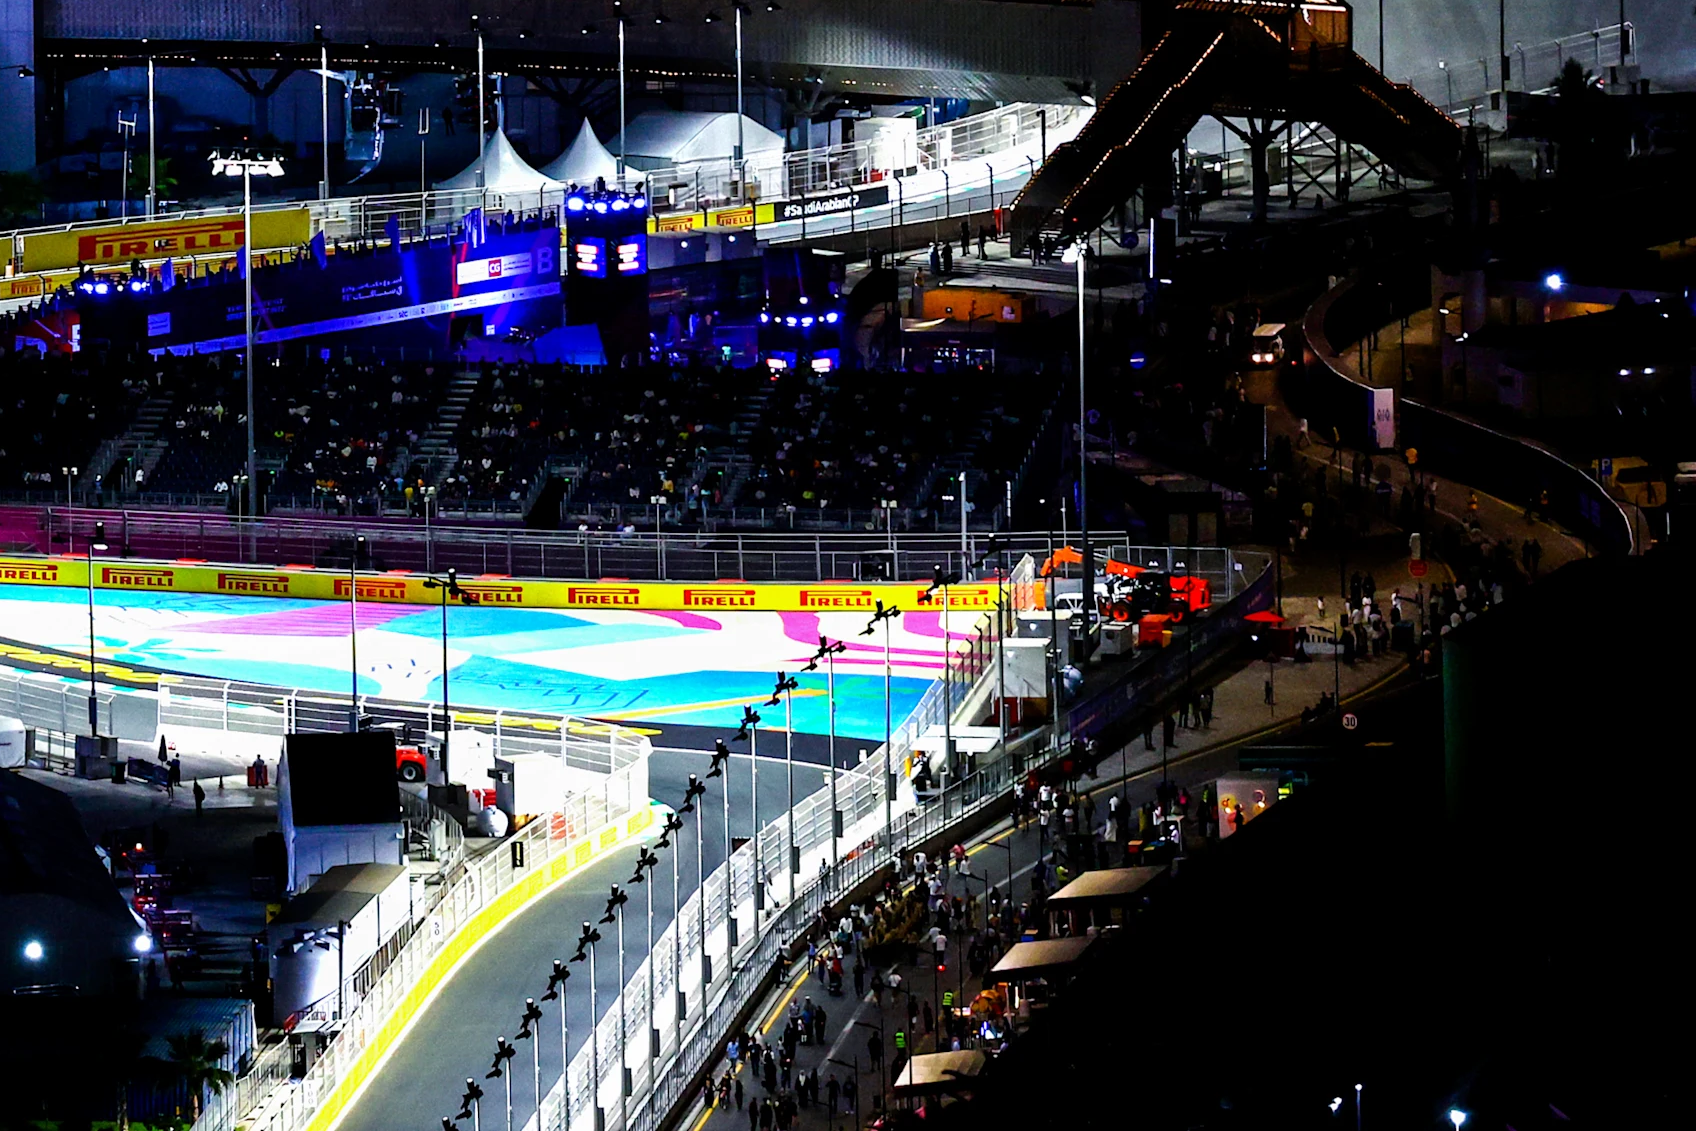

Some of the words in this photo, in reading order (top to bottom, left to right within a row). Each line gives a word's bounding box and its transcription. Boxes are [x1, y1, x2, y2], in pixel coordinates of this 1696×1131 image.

[102, 567, 174, 587] PIRELLI
[218, 573, 290, 593] PIRELLI
[334, 579, 407, 600] PIRELLI
[568, 587, 640, 605] PIRELLI
[683, 589, 756, 606] PIRELLI
[800, 590, 872, 607] PIRELLI
